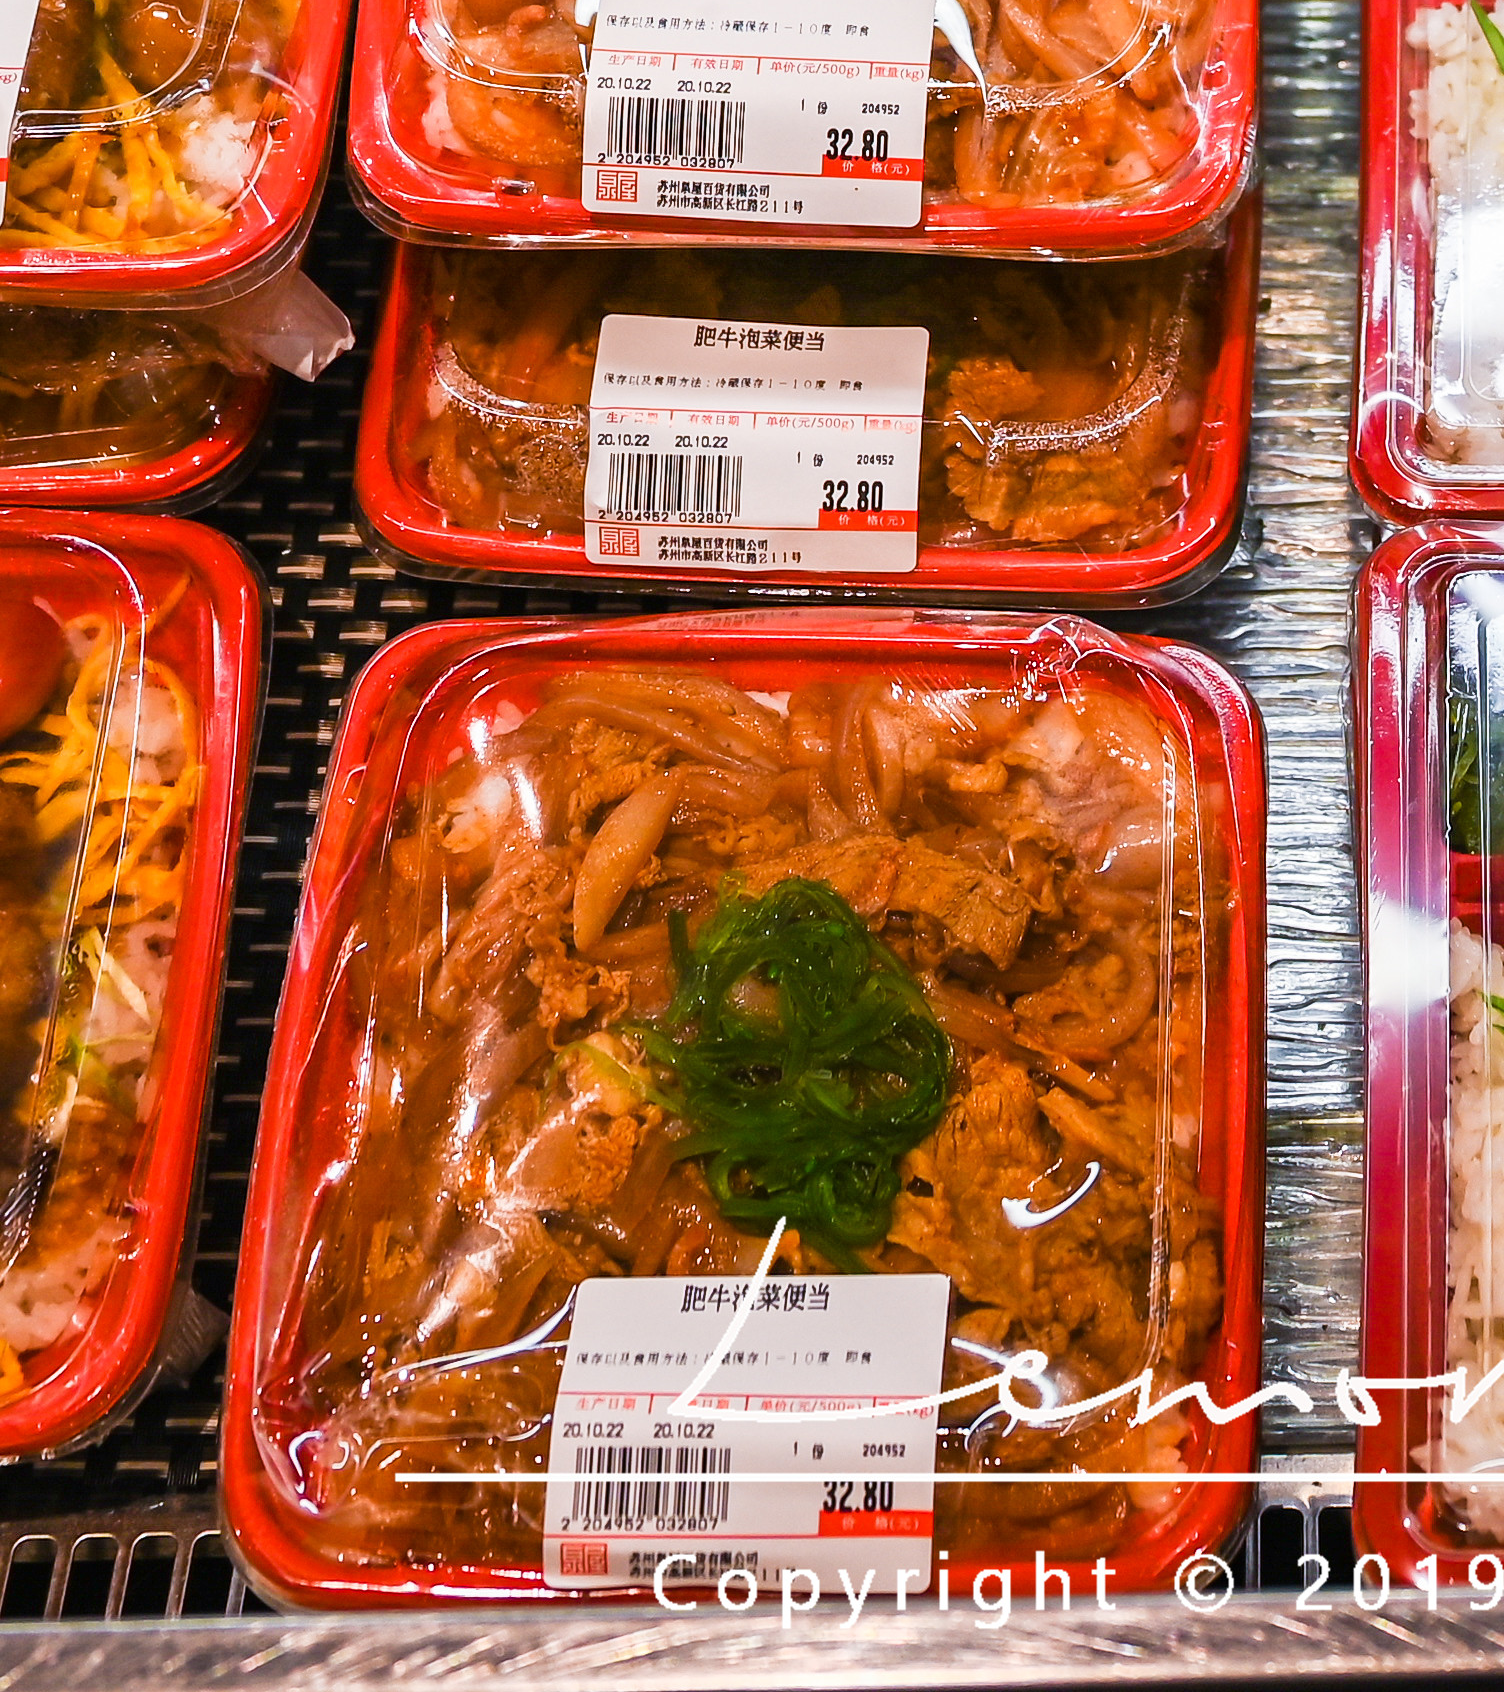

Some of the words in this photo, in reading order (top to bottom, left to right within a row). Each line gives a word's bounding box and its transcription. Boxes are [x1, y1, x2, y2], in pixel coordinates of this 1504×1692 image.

[608, 54, 661, 68] 生产日期
[691, 57, 744, 71] 有效日期
[769, 60, 860, 78] 单价(元/500g)
[874, 66, 925, 82] 重量(kg)
[597, 77, 651, 90] 20.10.22
[677, 80, 731, 94] 20.10.22
[862, 103, 900, 115] 204952
[826, 128, 889, 162] 32.80
[616, 153, 670, 166] 204952
[680, 156, 734, 169] 032807
[694, 324, 825, 352] 肥牛泡菜便当
[597, 433, 650, 447] 20.10.22
[675, 435, 729, 449] 20.10.22
[856, 454, 895, 466] 204952
[822, 480, 884, 513] 32.80
[563, 1422, 624, 1439] 20.10.22
[653, 1423, 715, 1439] 20.10.22
[862, 1443, 906, 1457] 204952
[823, 1481, 893, 1513] 32.80
